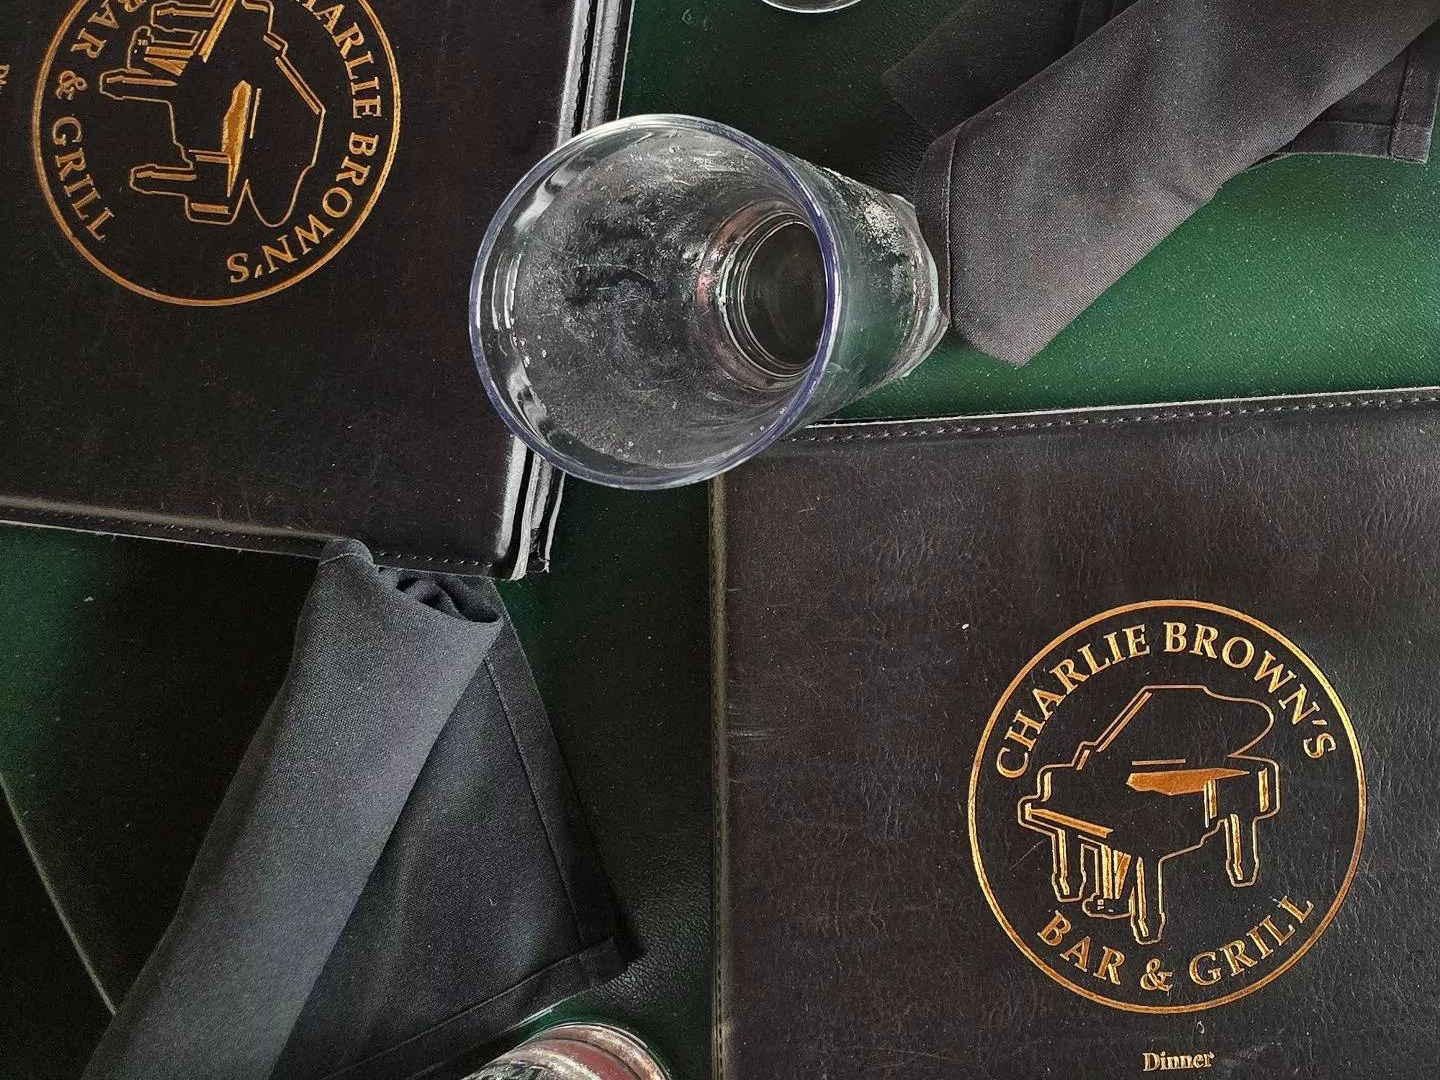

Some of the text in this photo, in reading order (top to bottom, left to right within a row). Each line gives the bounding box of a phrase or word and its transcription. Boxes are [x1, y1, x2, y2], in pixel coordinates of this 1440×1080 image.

[56, 70, 88, 101] &
[52, 116, 115, 242] GRILL
[226, 132, 379, 283] BROWN'S
[997, 621, 1337, 779] CHARLIE BROWN'S
[1036, 895, 1315, 994] BAR & GRILL
[1142, 1050, 1215, 1072] Dinner
